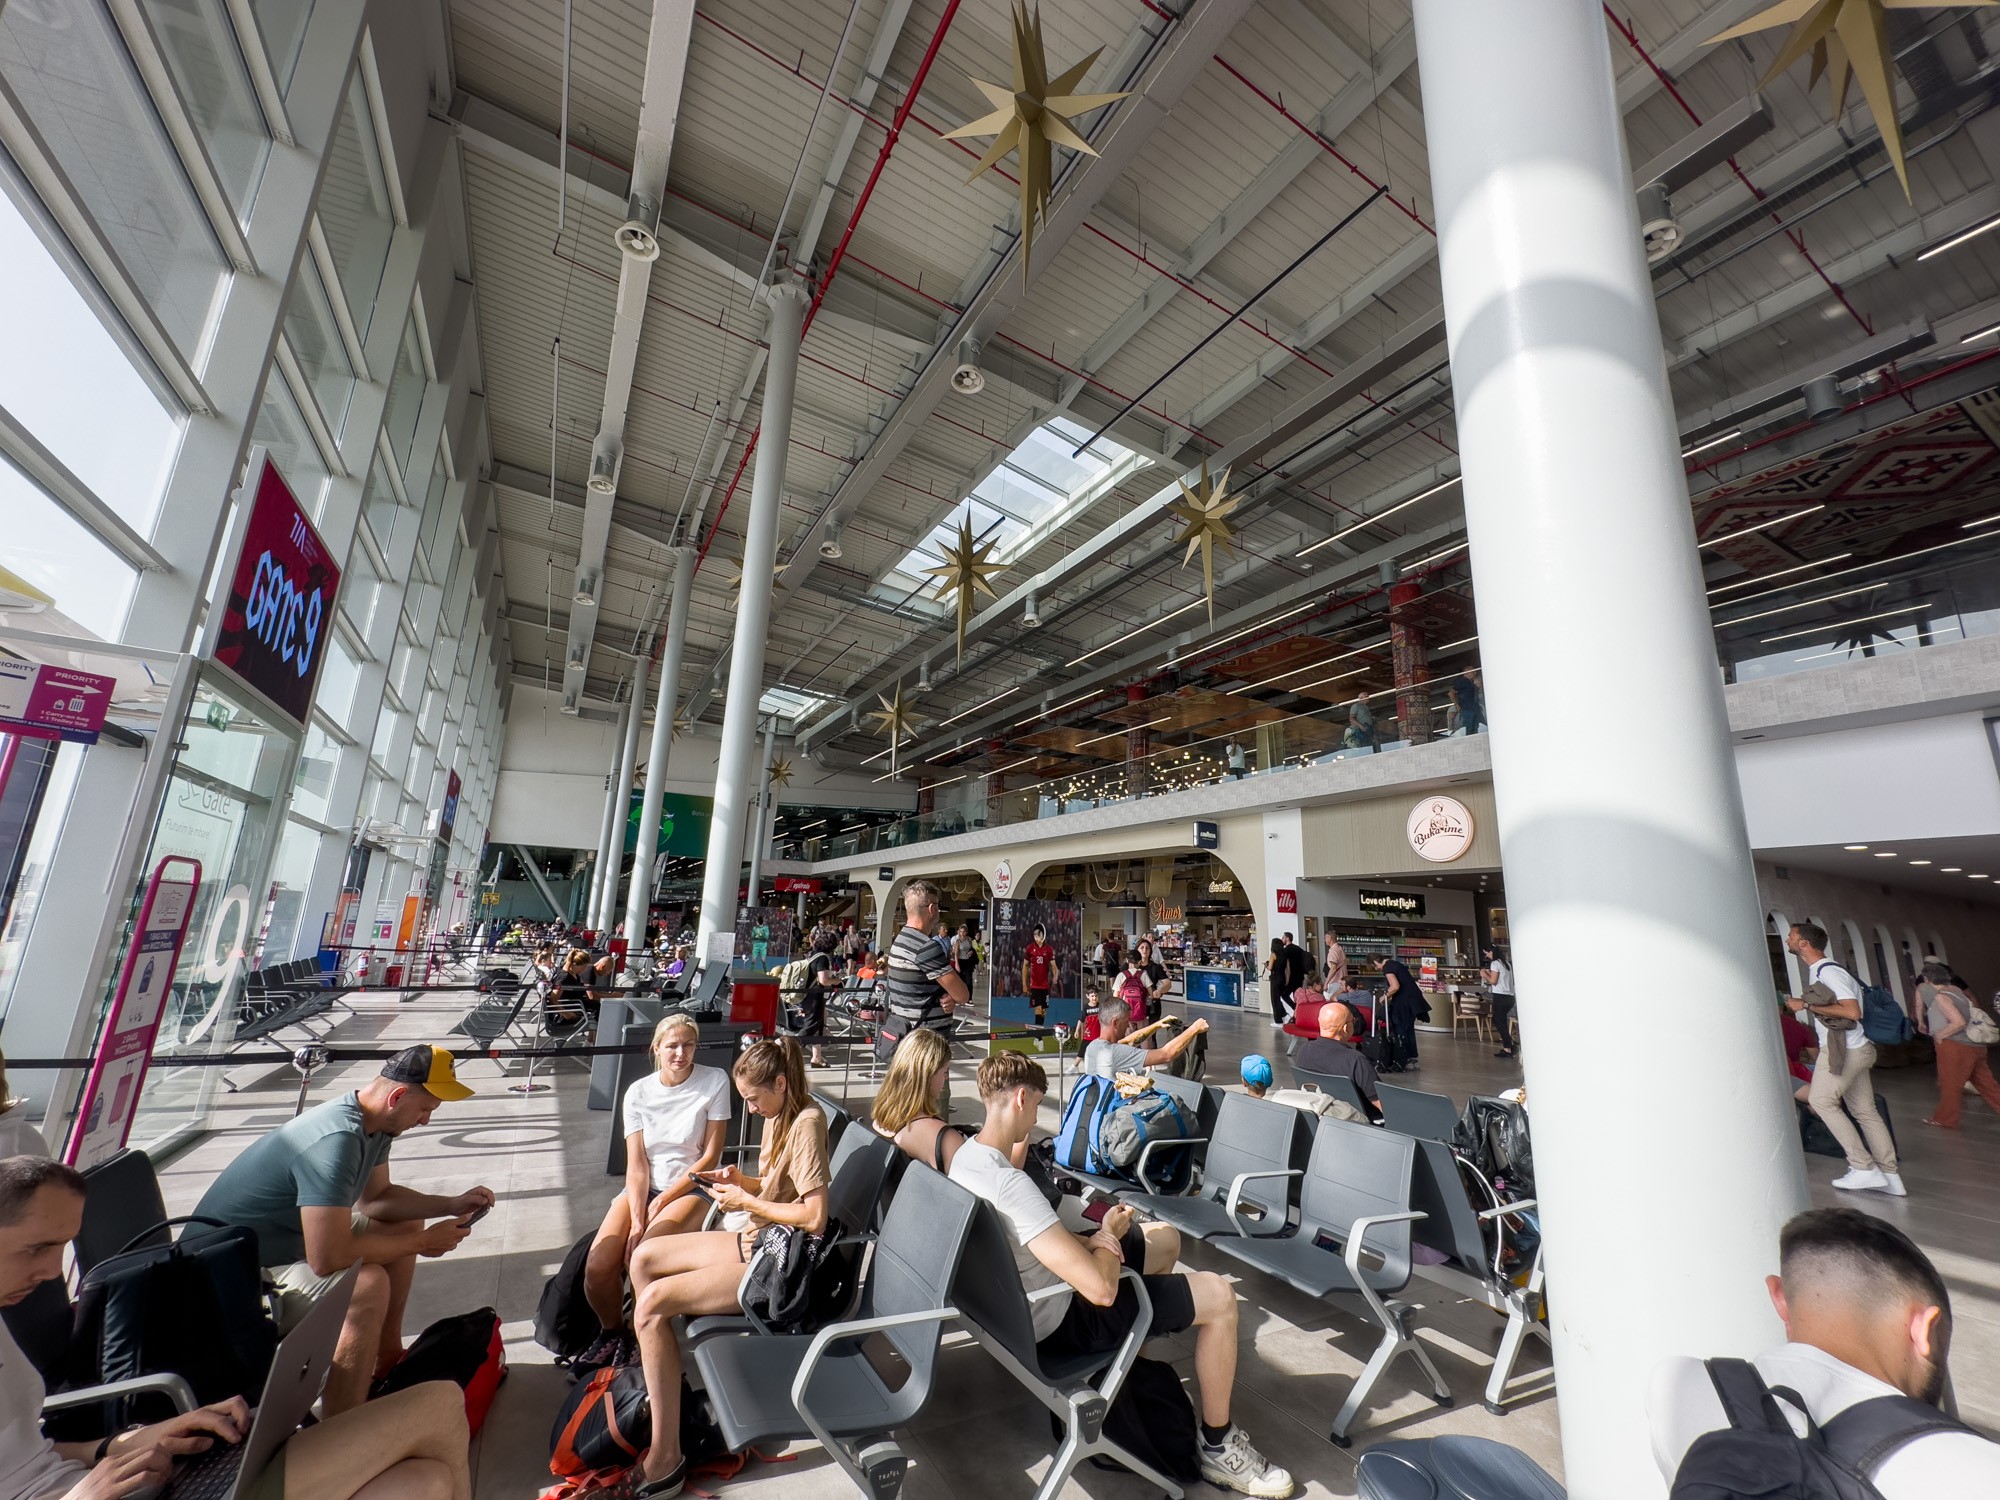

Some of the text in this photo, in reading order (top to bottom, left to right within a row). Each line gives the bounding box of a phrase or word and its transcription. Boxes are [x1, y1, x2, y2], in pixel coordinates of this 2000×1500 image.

[297, 587, 322, 678] 9
[55, 671, 101, 685] PRIORITY
[51, 716, 74, 725] Trolley
[76, 715, 90, 723] bag
[202, 781, 232, 816] Gate
[1278, 893, 1295, 911] illy
[1360, 893, 1417, 910] Love at first flight
[1149, 897, 1183, 924] Amor
[185, 884, 250, 1046] 9
[1036, 956, 1044, 965] 20
[1085, 1409, 1102, 1418] TRAVEL
[1224, 1453, 1244, 1471] N
[878, 1470, 900, 1481] TRAVEL
